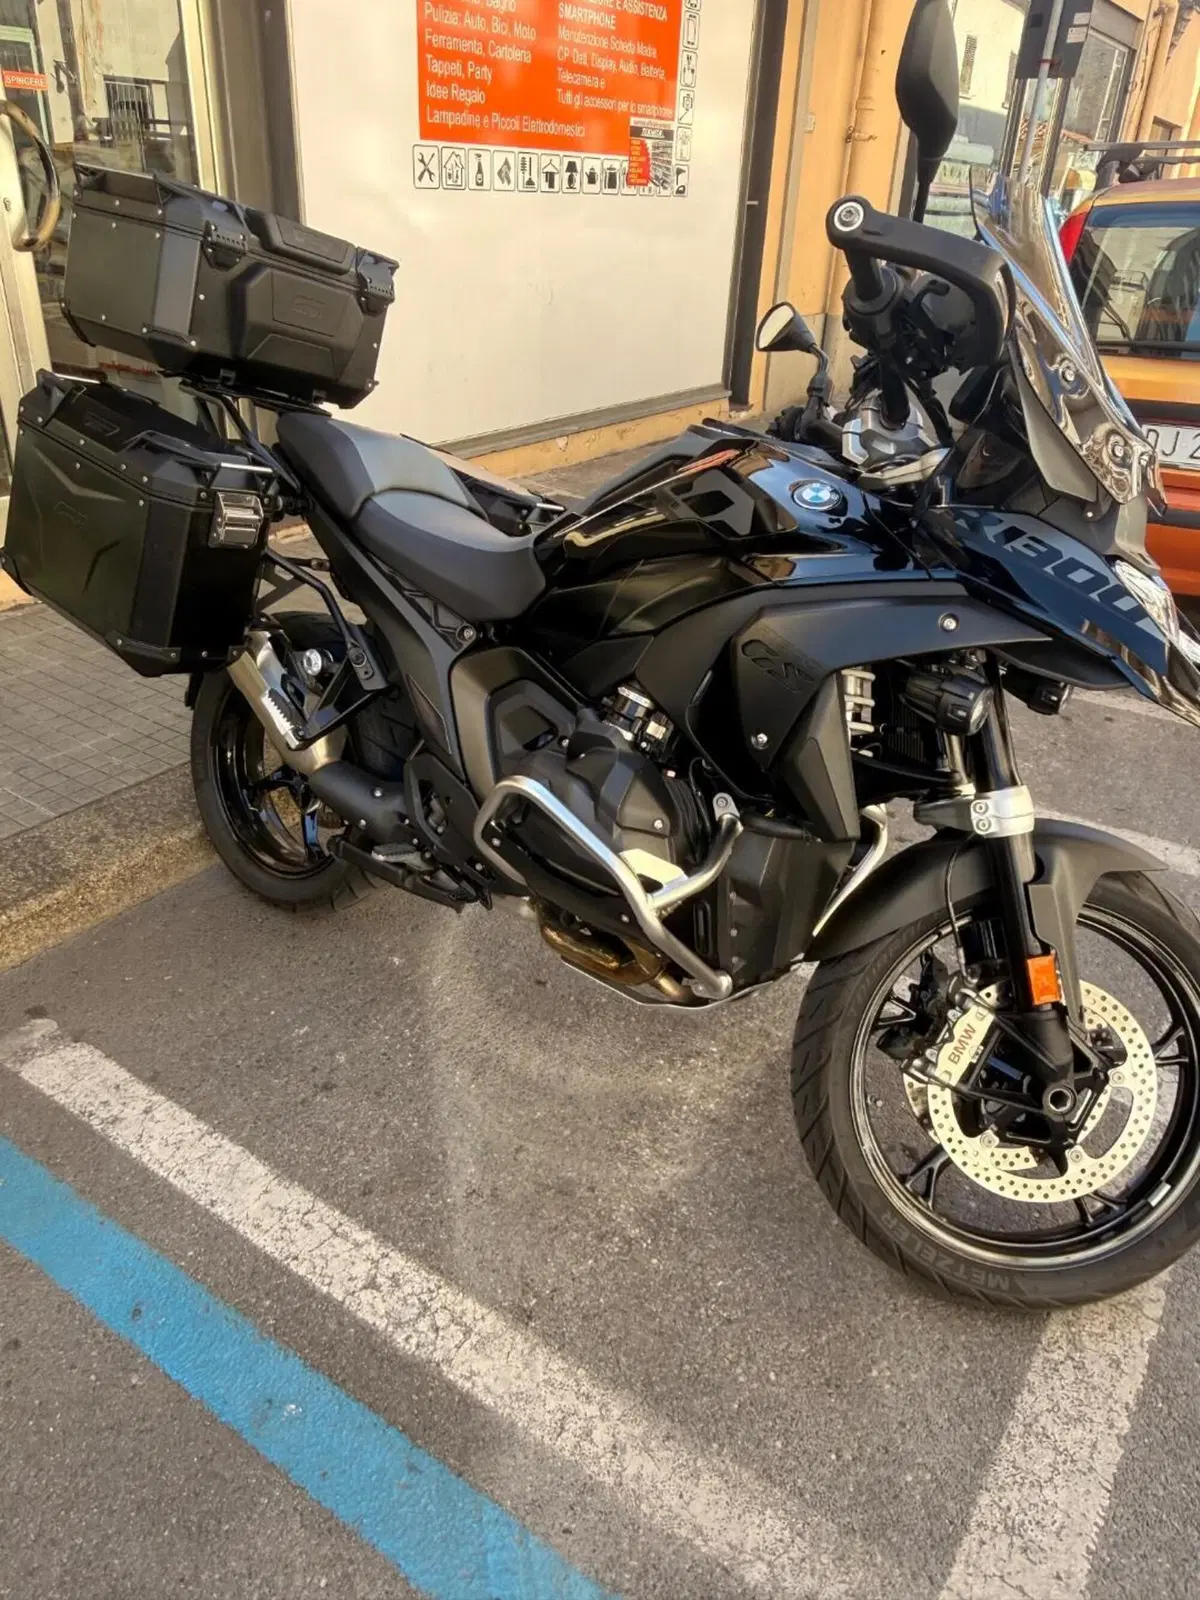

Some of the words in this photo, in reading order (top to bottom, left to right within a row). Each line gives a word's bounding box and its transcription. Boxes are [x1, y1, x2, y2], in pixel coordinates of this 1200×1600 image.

[559, 3, 616, 30] SMARTPHONE
[513, 20, 536, 41] Moto
[7, 75, 45, 86] SPINGERE
[426, 54, 465, 80] Tappeti,
[467, 61, 493, 85] Party
[557, 67, 599, 88] Telecamera
[600, 78, 606, 89] e
[426, 80, 449, 99] Idee
[451, 83, 486, 107] Regalo
[427, 104, 480, 129] Lampadine
[483, 116, 489, 128] e
[948, 1023, 976, 1065] BMW
